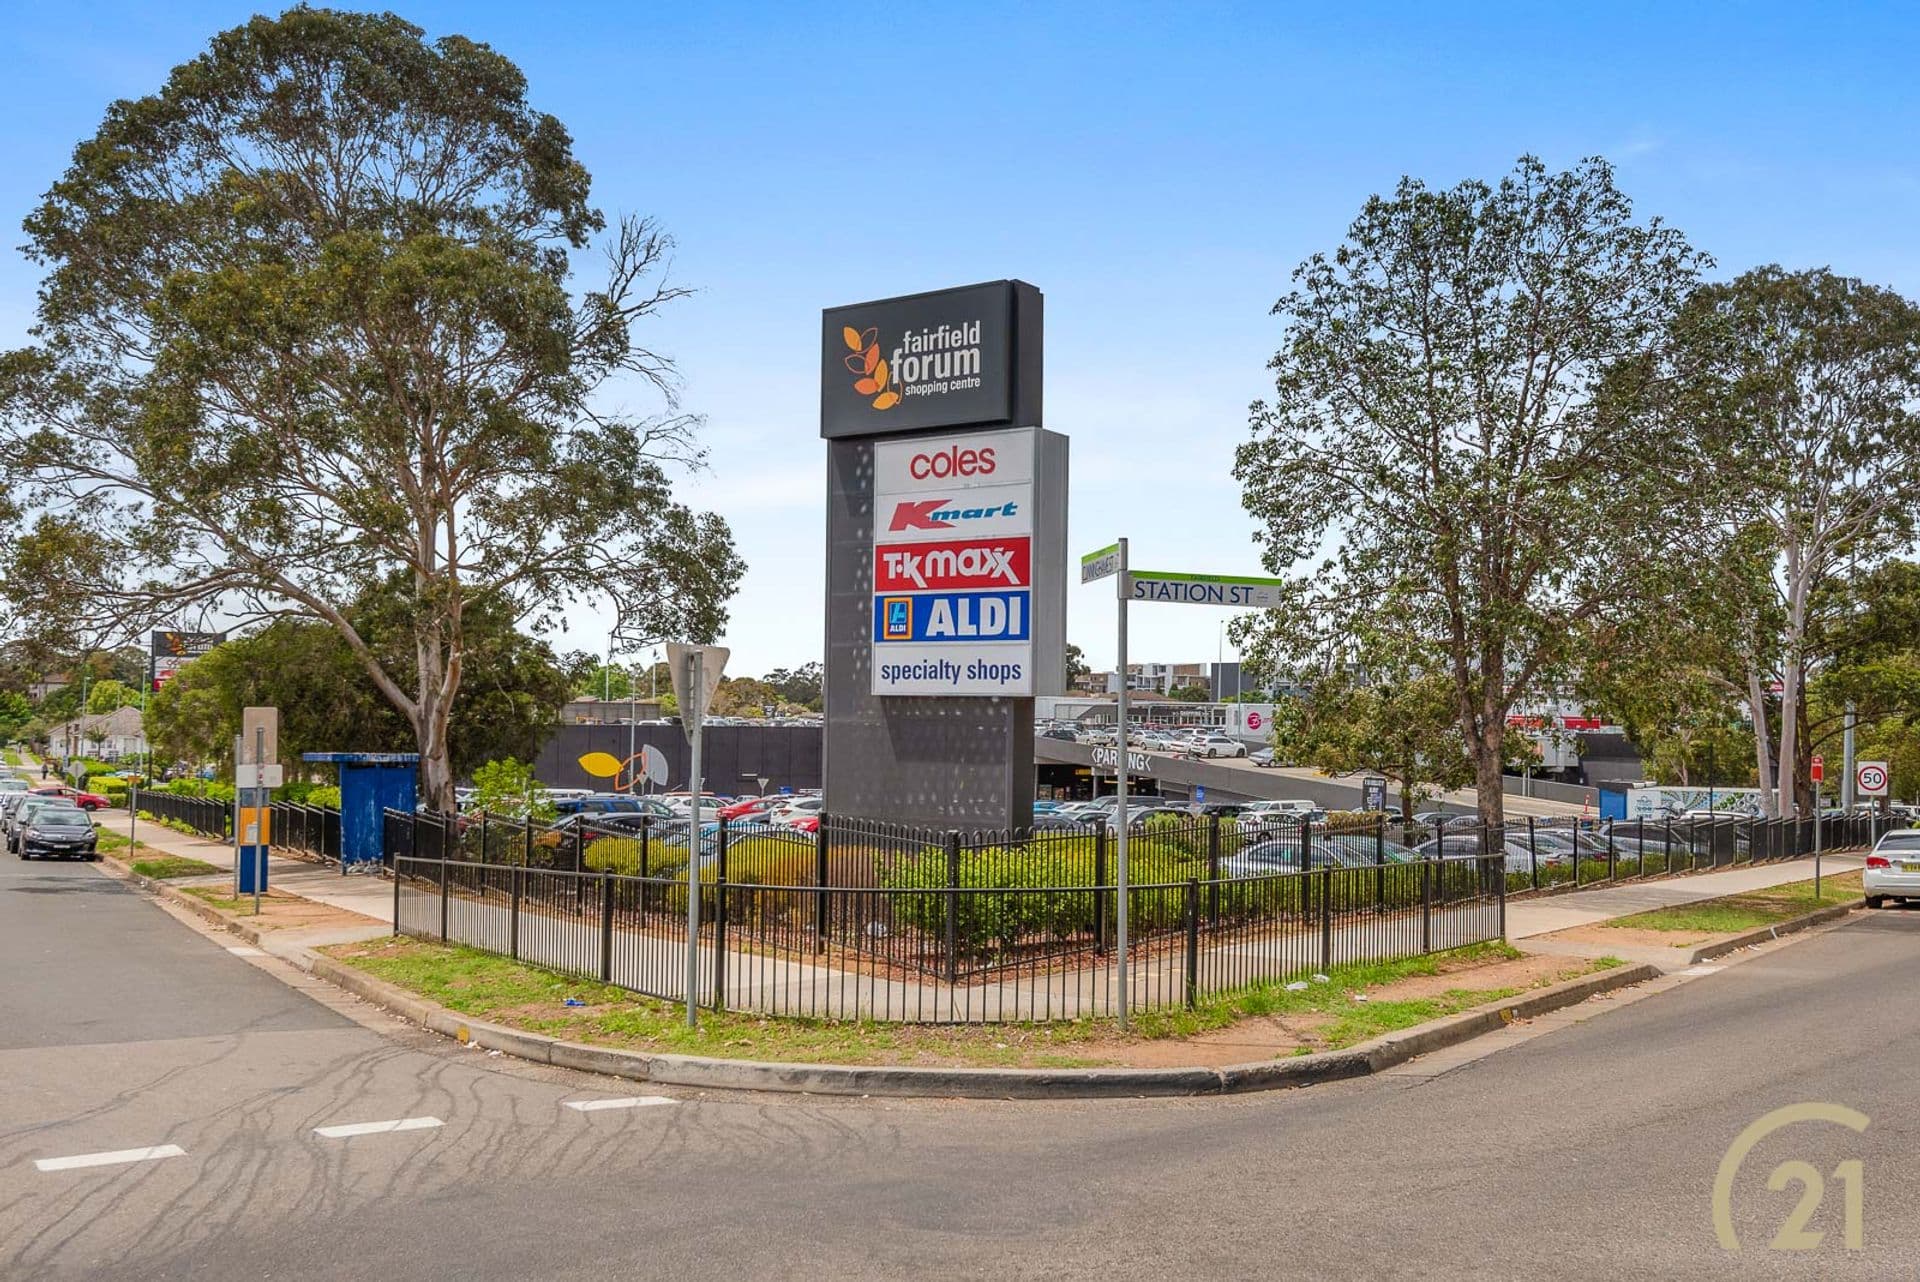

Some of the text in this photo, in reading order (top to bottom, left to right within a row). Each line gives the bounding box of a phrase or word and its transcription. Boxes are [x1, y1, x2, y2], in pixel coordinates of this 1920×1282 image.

[903, 320, 981, 354] fairfield
[890, 347, 981, 384] forum
[905, 377, 981, 396] shopping centre
[910, 445, 996, 480] coles
[888, 499, 1018, 532] Kmart
[1135, 580, 1223, 602] STATION
[1230, 585, 1254, 604] ST
[890, 624, 907, 633] ALDI
[925, 596, 1022, 637] ALDI
[881, 658, 1022, 686] specialty shops
[1096, 747, 1145, 771] PARNG
[1863, 772, 1882, 784] 50
